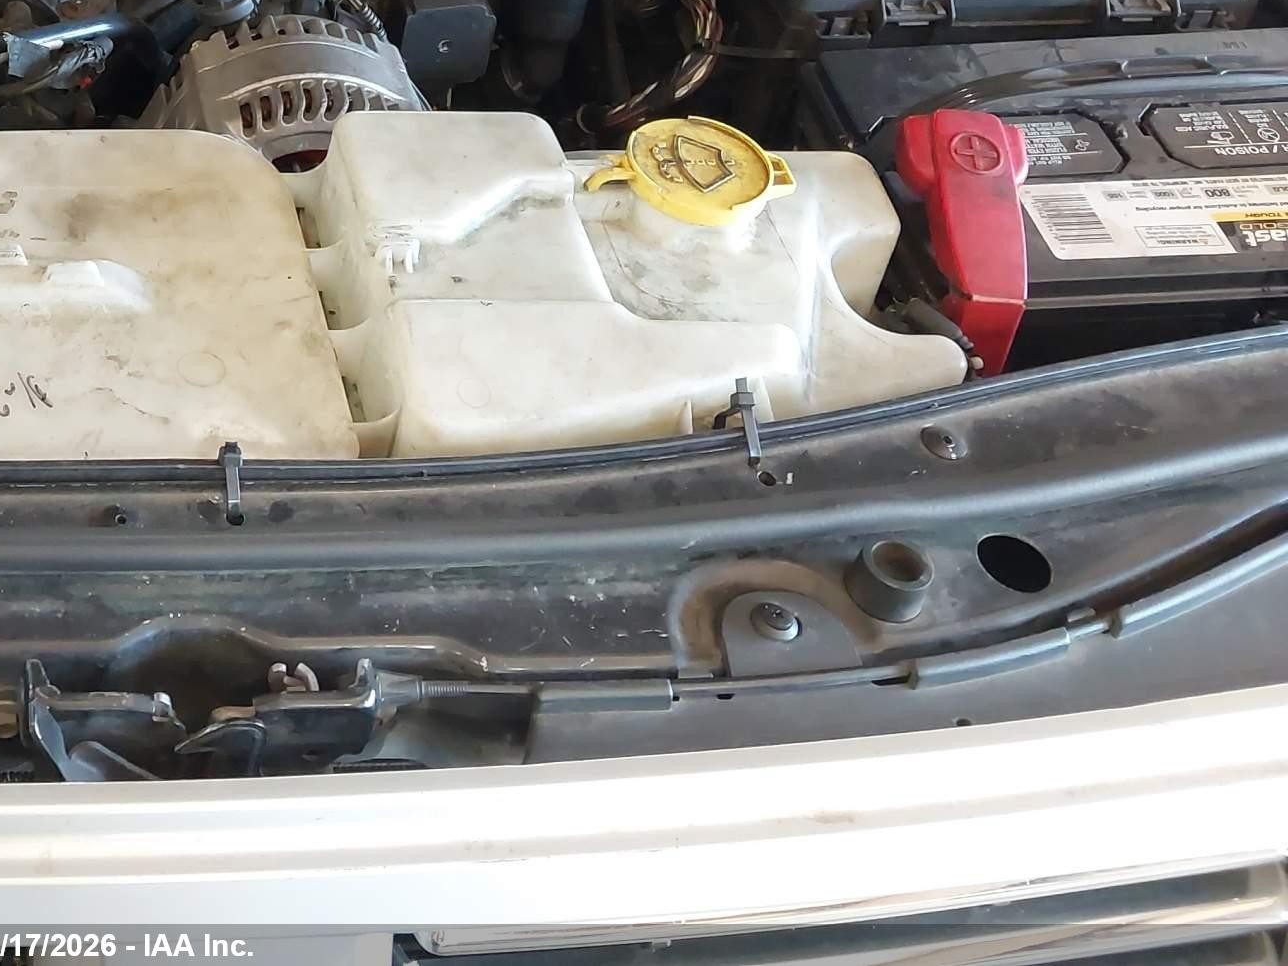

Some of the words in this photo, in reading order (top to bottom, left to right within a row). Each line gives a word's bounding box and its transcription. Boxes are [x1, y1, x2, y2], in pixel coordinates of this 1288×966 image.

[1214, 145, 1269, 156] POISON
[1205, 188, 1231, 198] 800
[1242, 229, 1288, 247] ast
